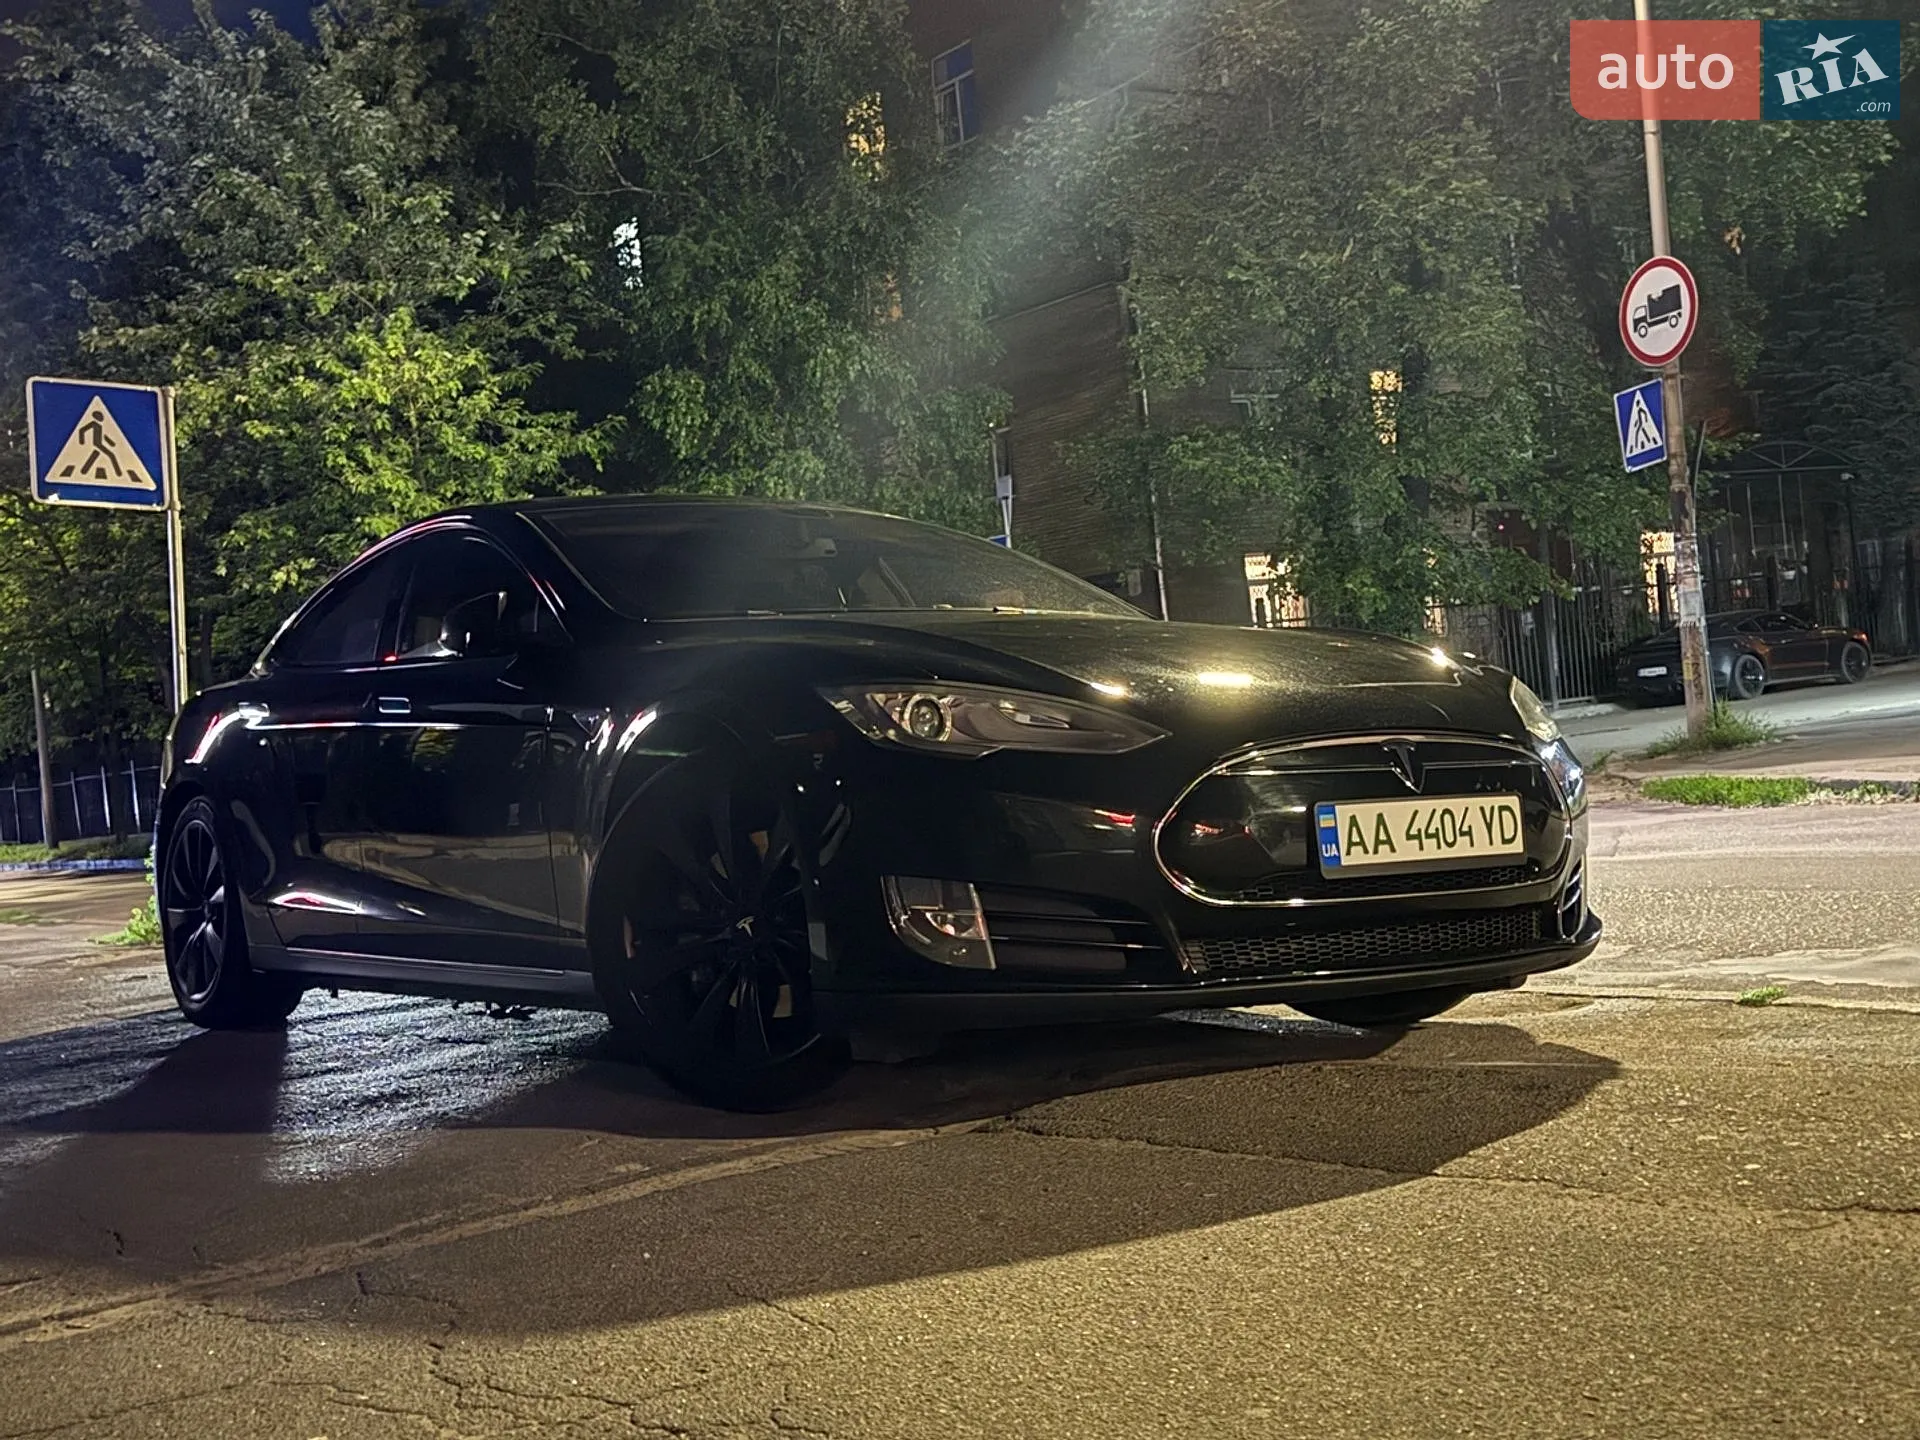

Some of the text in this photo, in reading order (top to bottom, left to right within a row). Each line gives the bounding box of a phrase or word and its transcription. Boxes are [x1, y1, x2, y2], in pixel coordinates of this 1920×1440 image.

[1345, 804, 1518, 856] AA 4404 YD
[1322, 843, 1339, 857] UA
